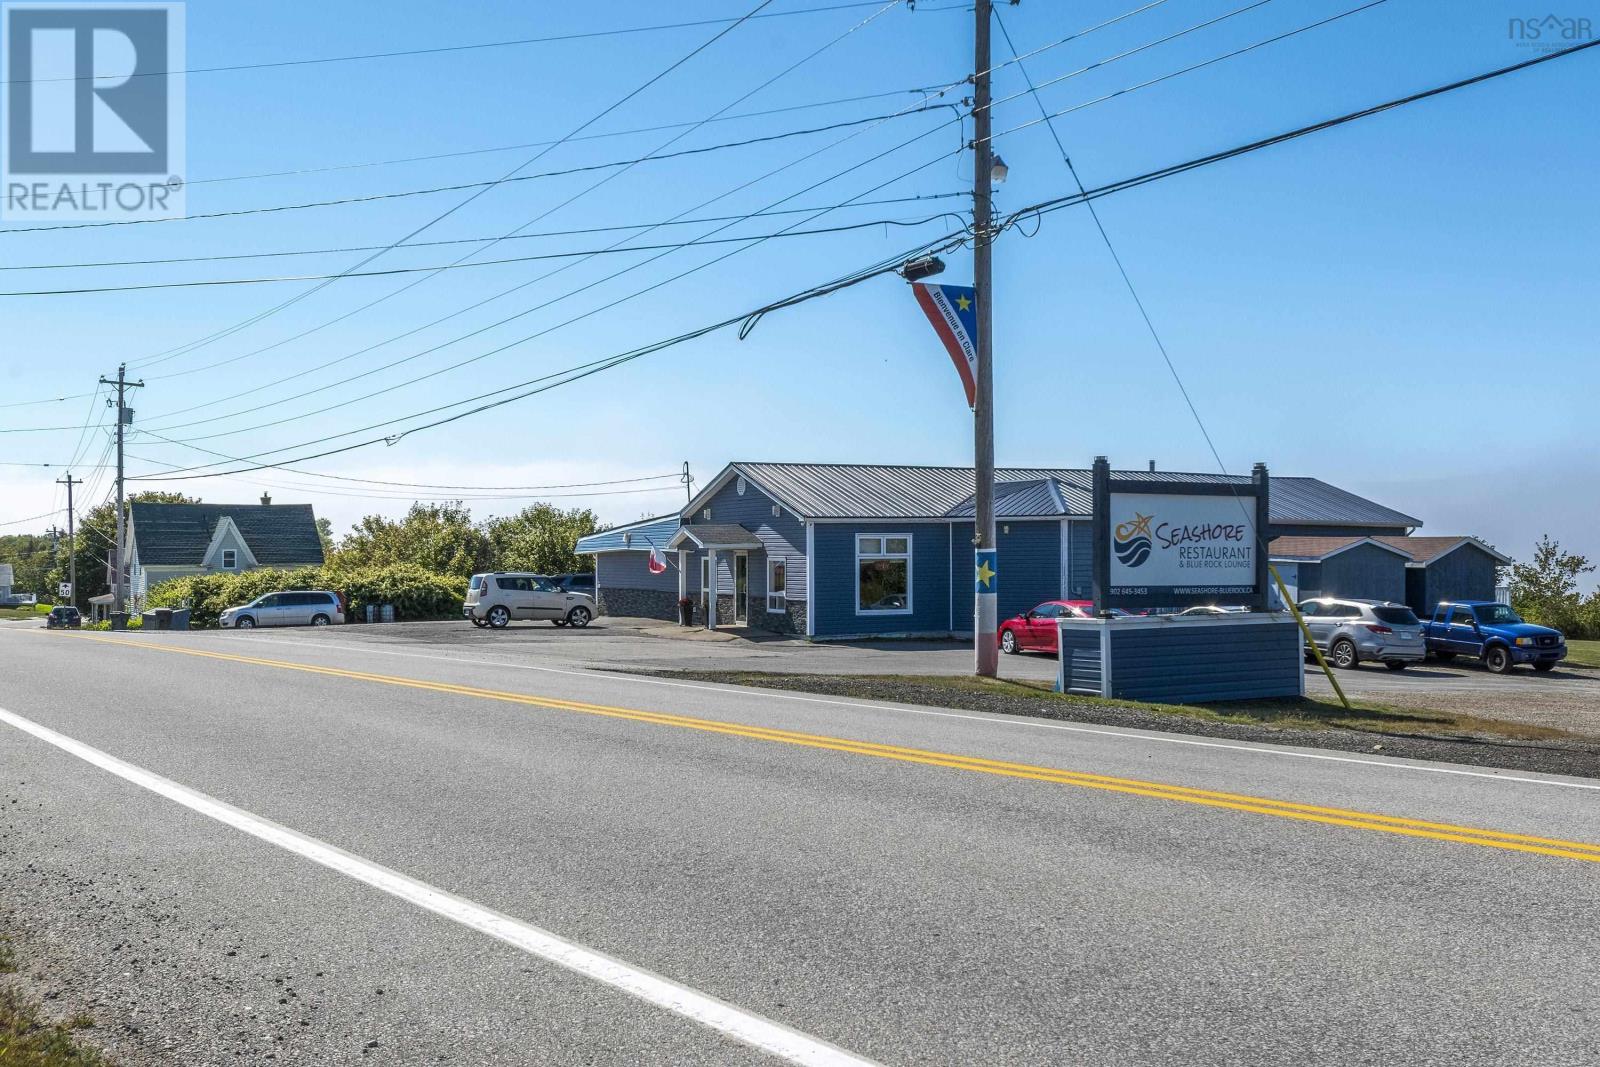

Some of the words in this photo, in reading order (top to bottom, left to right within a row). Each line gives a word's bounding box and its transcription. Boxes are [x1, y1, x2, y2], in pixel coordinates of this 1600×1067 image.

[933, 291, 960, 331] Bienvenue
[956, 330, 965, 341] en
[962, 341, 975, 362] Clare
[1179, 546, 1252, 560] RESTAURANT
[1178, 561, 1184, 569] &
[1186, 561, 1202, 569] BLUE
[1204, 561, 1223, 569] ROCK
[1224, 560, 1251, 569] LOUNGE
